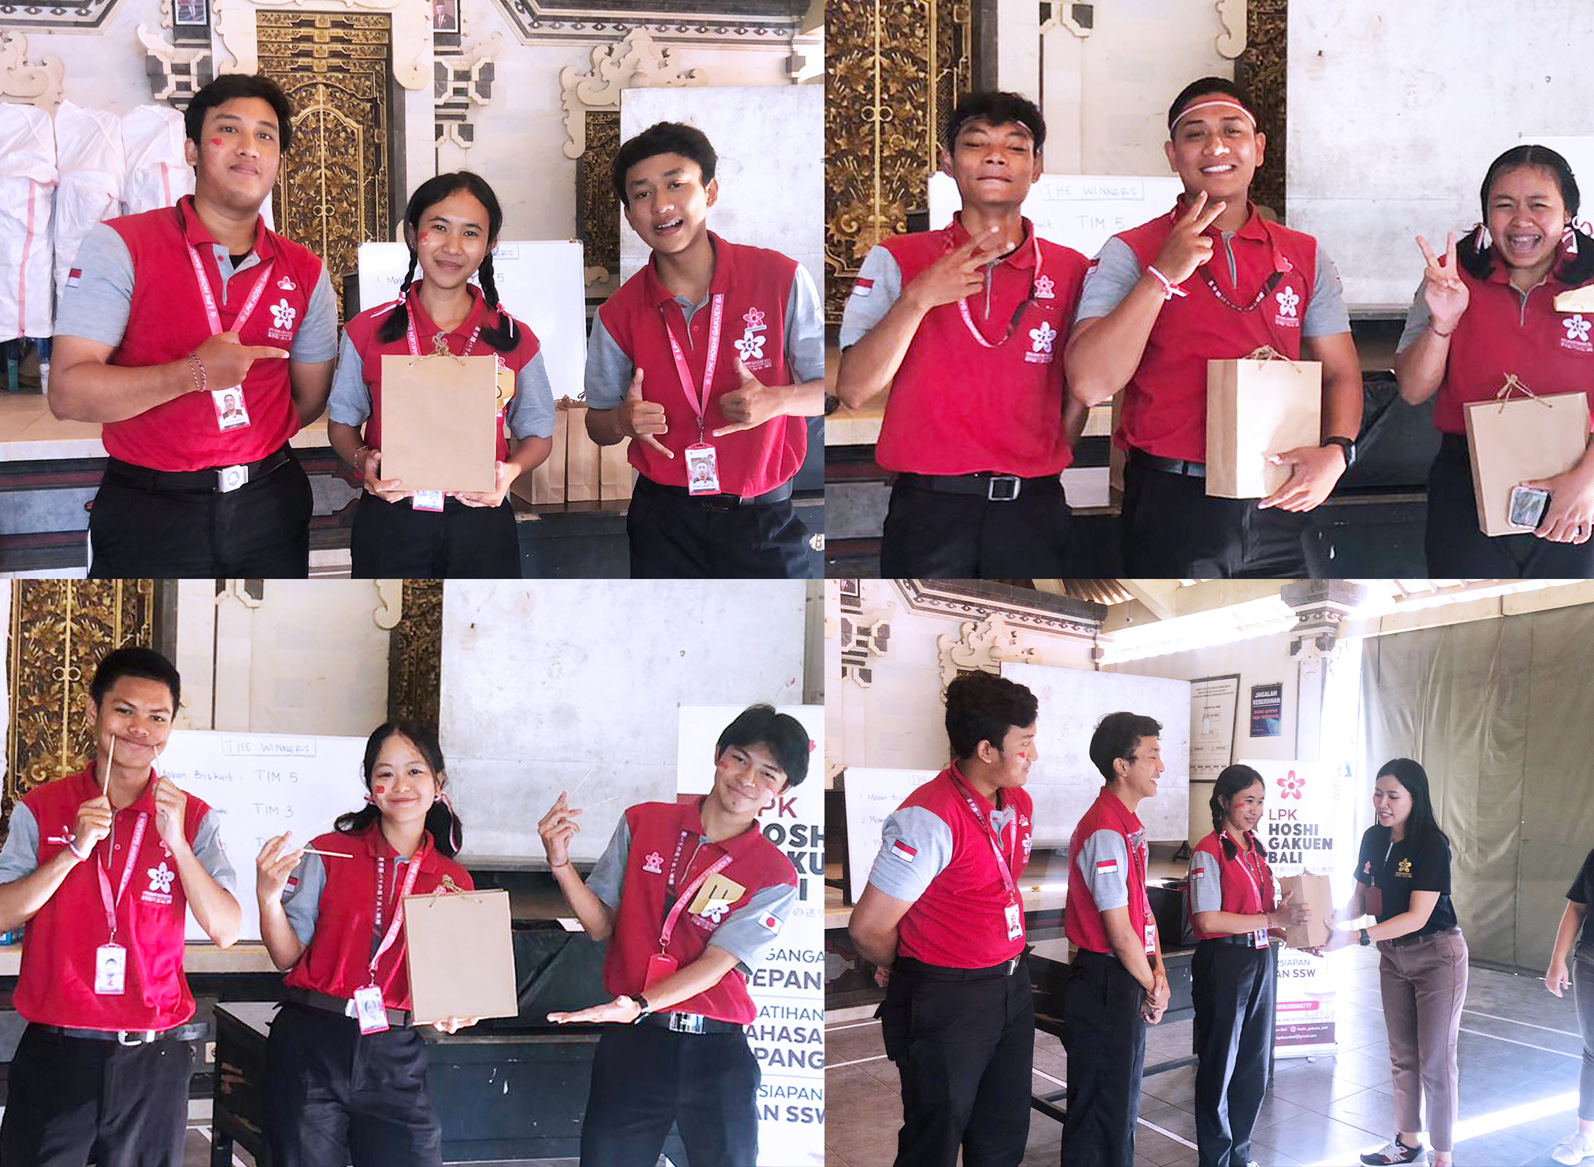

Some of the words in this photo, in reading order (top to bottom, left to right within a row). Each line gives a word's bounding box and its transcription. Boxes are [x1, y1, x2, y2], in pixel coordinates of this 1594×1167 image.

[1045, 184, 1073, 197] THE
[1076, 215, 1105, 229] TIM
[1115, 217, 1125, 229] 5
[1253, 697, 1280, 706] KEBERSIHAN
[1255, 690, 1277, 699] JAGALAH
[228, 740, 251, 753] THE
[261, 742, 310, 754] WINNERS
[254, 769, 281, 783] TIM
[290, 772, 299, 783] 5
[911, 774, 927, 784] THE
[253, 802, 279, 816] TIM
[286, 805, 294, 818] 3
[758, 797, 797, 818] PK
[1269, 809, 1297, 821] LPK
[762, 822, 825, 848] OSH
[1268, 823, 1319, 836] HOSHI
[1268, 837, 1333, 850] GAKUEN
[787, 851, 825, 875] KU
[1268, 851, 1303, 864] BALI
[752, 969, 823, 990] EPAN
[1293, 969, 1316, 978] SSW
[758, 1005, 824, 1021] ATIHAN
[745, 1025, 823, 1044] AHASA
[752, 1047, 825, 1070] PANG
[758, 1084, 823, 1100] SIAPAN
